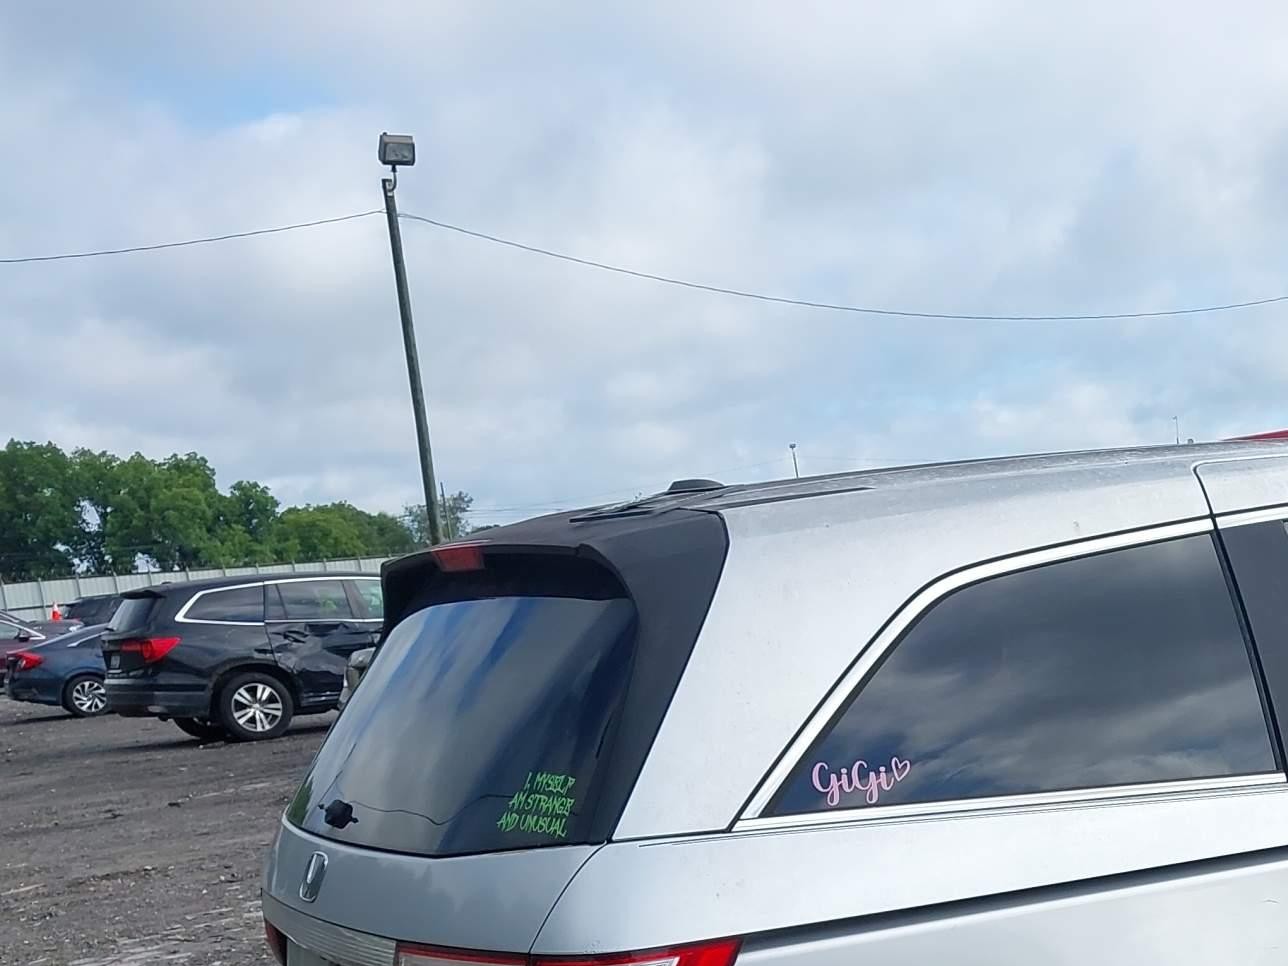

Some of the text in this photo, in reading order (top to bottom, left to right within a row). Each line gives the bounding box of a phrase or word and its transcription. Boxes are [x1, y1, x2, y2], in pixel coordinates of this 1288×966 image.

[534, 772, 576, 795] MYSELF
[812, 760, 894, 806] GiGi
[508, 792, 575, 817] AM STRANGE
[497, 812, 567, 838] AND UNUSUAL
